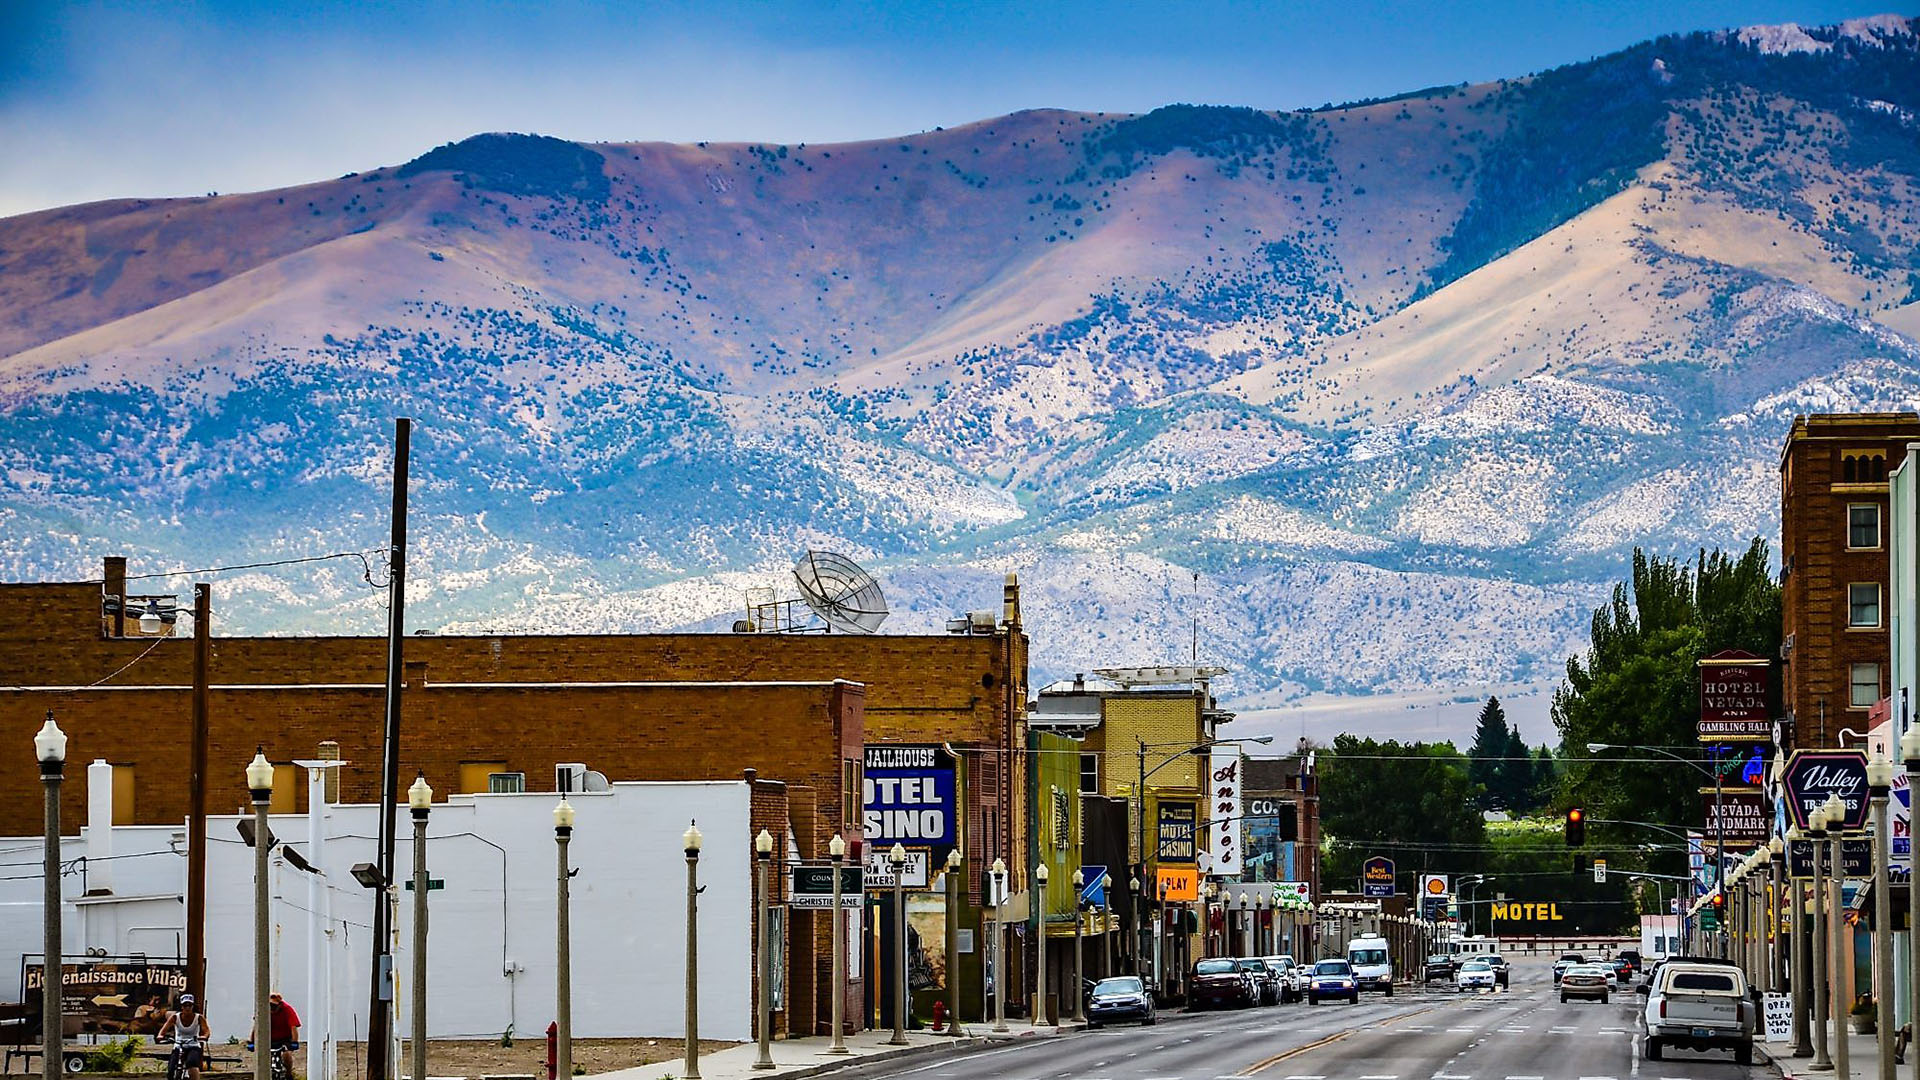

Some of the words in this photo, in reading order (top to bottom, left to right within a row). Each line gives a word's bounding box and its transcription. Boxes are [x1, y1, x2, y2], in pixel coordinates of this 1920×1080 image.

[1705, 682, 1764, 693] HOTEL
[1705, 697, 1764, 708] NEVADA
[1700, 723, 1745, 732] GAMBLING
[1748, 723, 1770, 731] HALL
[866, 749, 935, 767] JAILHOUSE
[1802, 765, 1862, 796] Valley
[1251, 801, 1278, 814] CO.
[1711, 805, 1761, 816] NEVADA
[864, 810, 944, 838] SINO
[1706, 818, 1766, 829] LANDMARK
[1160, 823, 1192, 839] MOTEL
[1160, 841, 1192, 857] CASINO
[864, 876, 894, 885] MAKERS
[1167, 877, 1188, 890] PLAY
[1491, 903, 1563, 921] MOTEL
[61, 968, 143, 985] enaissance
[146, 969, 188, 991] Villag
[1768, 1001, 1790, 1010] OPEN
